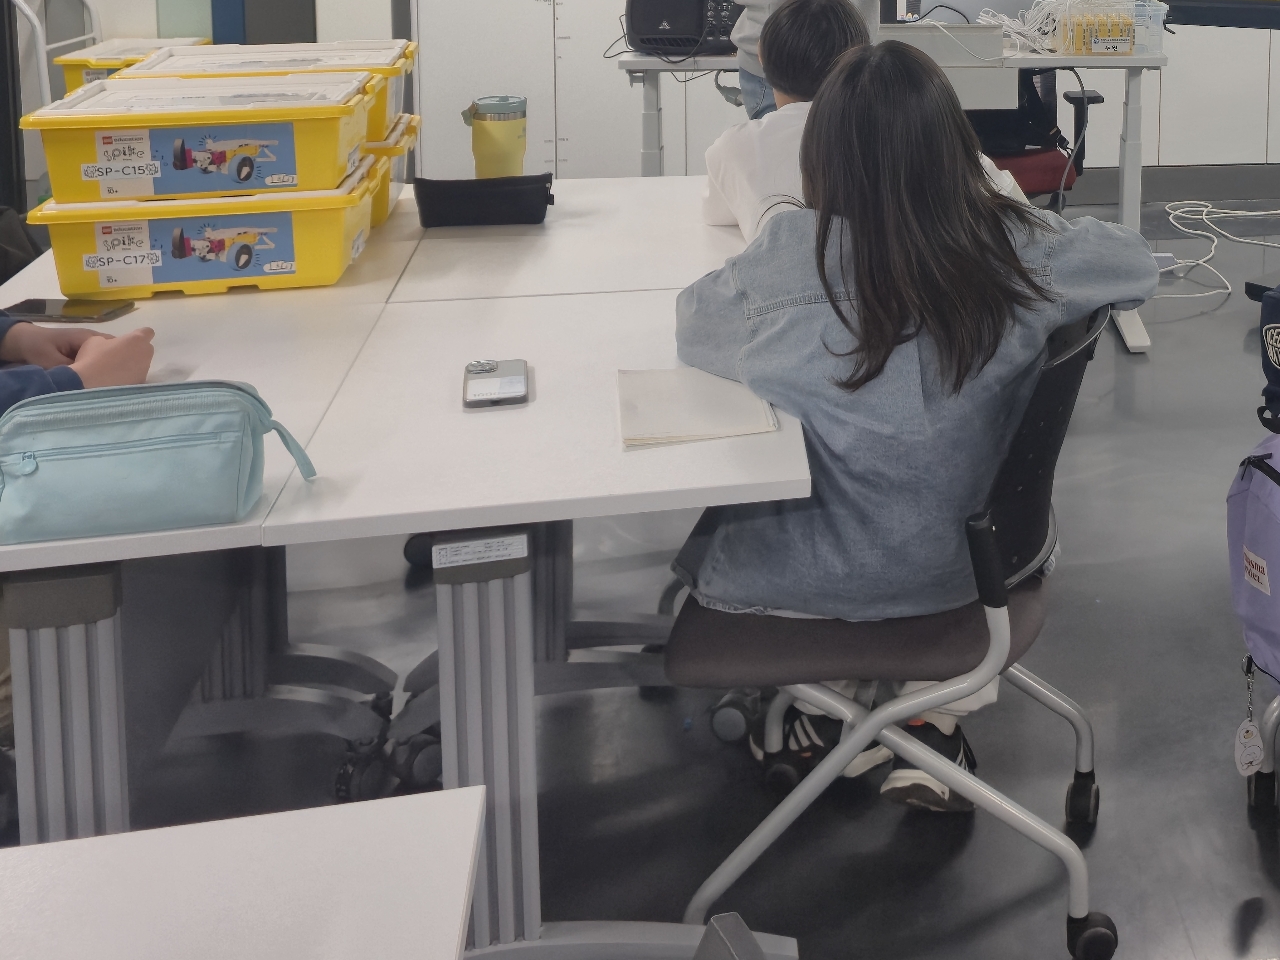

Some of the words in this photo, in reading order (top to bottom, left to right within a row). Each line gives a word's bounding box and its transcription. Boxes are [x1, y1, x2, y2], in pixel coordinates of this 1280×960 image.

[103, 145, 145, 162] spike
[97, 165, 146, 177] SP-C15
[103, 235, 145, 252] spike
[98, 255, 146, 267] SP-C17
